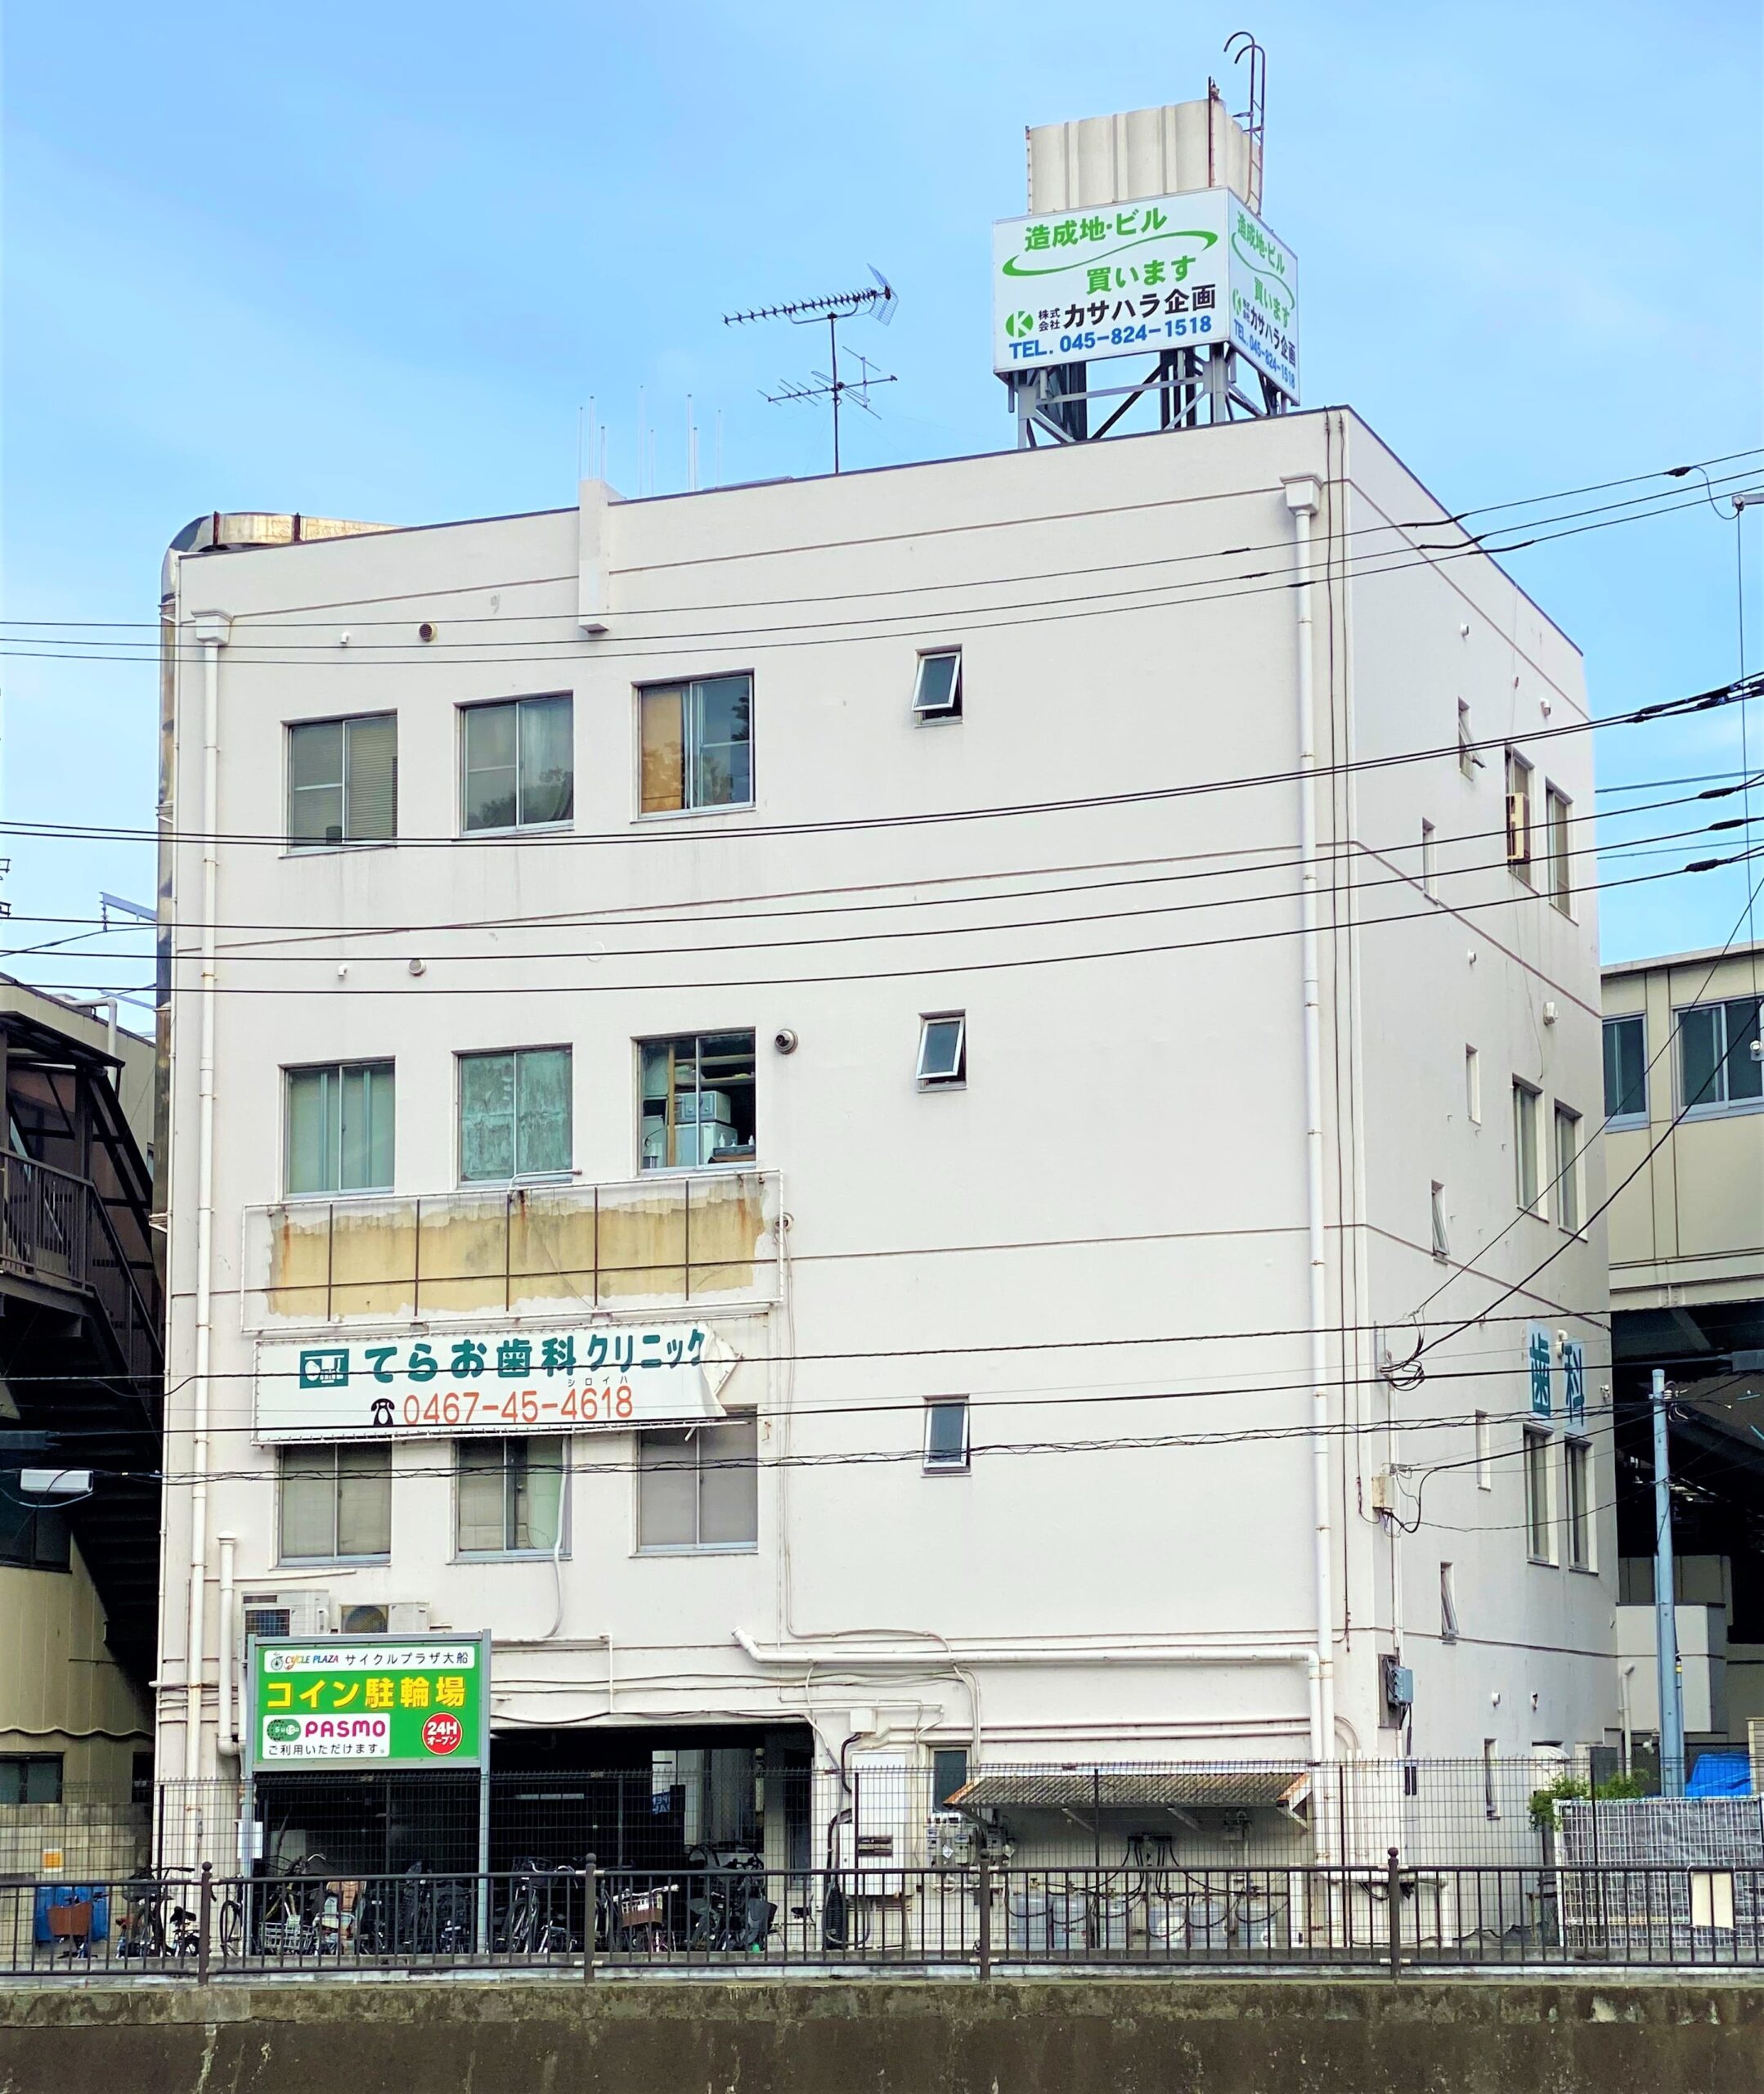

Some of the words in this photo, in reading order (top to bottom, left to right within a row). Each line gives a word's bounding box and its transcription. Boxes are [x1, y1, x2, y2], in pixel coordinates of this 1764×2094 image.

[1085, 255, 1196, 294] 買います
[1254, 276, 1290, 329] 買います
[1008, 339, 1053, 360] TEL.
[1059, 315, 1212, 353] 045-824-1518
[403, 1385, 634, 1426] 0467-45-4618
[312, 1654, 339, 1664] PLAZA
[345, 1651, 469, 1666] サイクルプラザ大船
[267, 1675, 466, 1710] コイン駐輪場
[305, 1719, 386, 1738] PASMO
[427, 1721, 458, 1736] 24H
[427, 1735, 458, 1746] オープン
[268, 1742, 385, 1756] ご利用いただけます。
